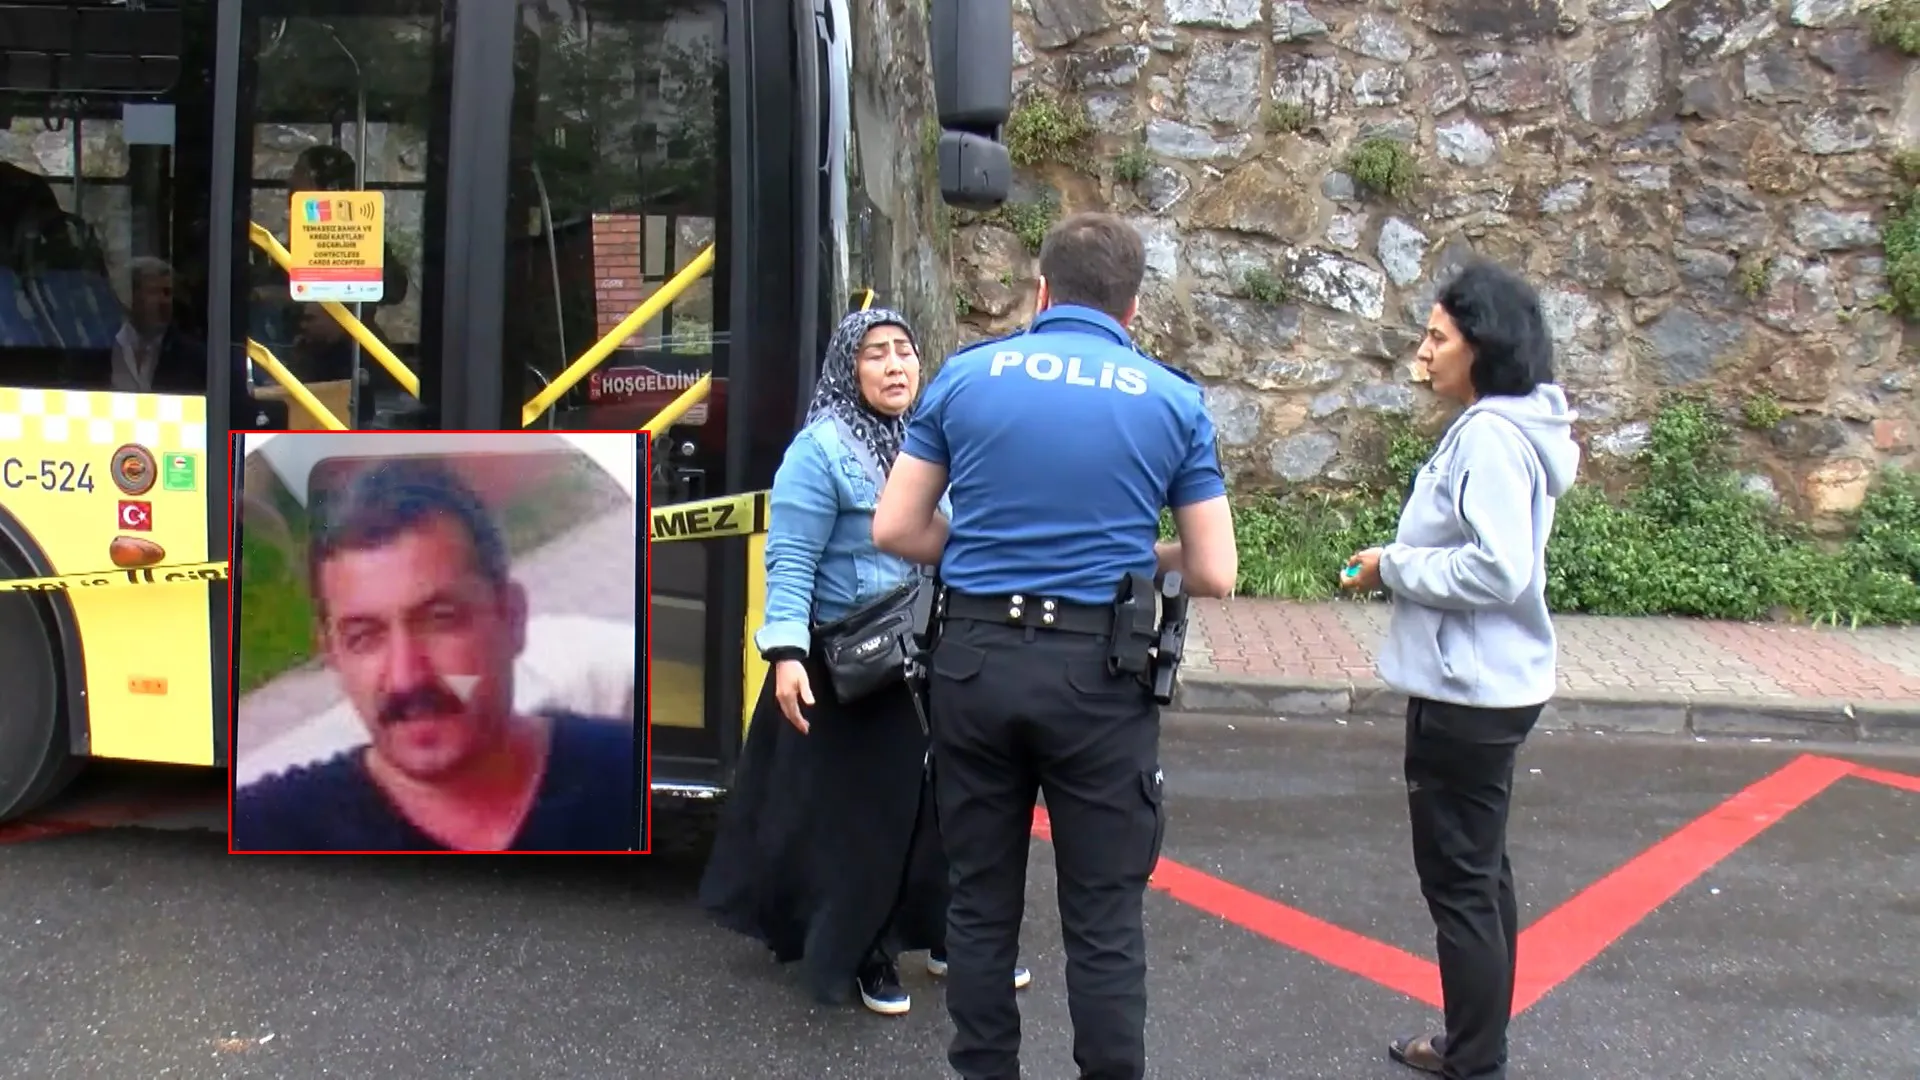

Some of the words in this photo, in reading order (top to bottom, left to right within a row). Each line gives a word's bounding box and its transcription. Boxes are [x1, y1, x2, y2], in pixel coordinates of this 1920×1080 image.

[602, 368, 710, 397] HOŞGELDİNİ
[3, 457, 95, 494] C-524
[651, 503, 738, 538] MEZ
